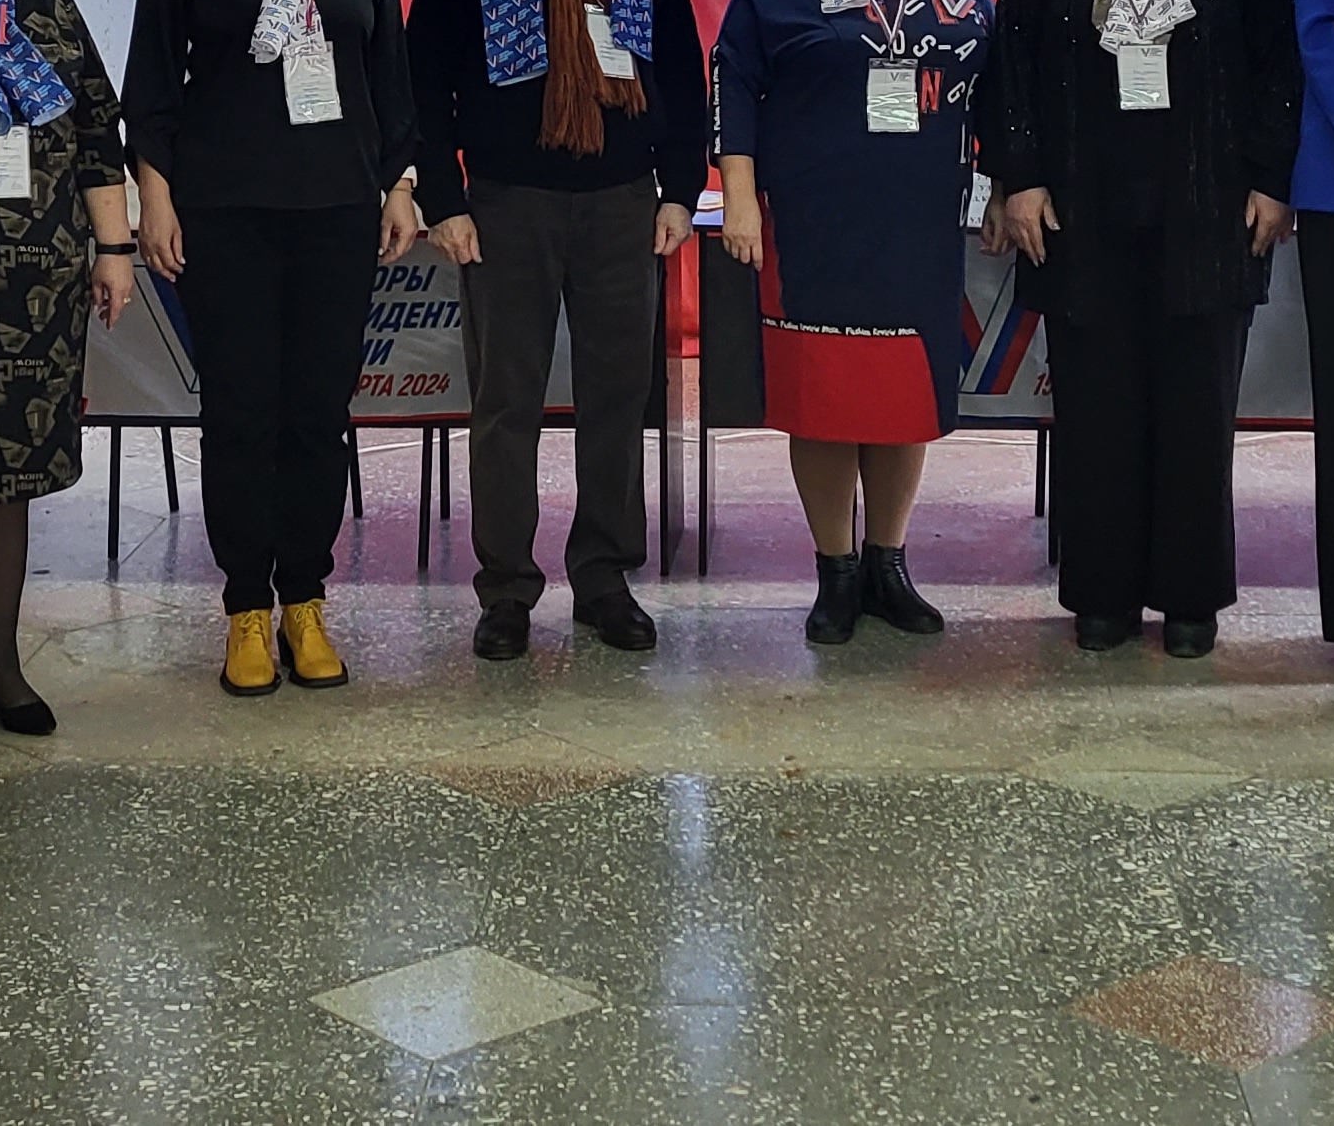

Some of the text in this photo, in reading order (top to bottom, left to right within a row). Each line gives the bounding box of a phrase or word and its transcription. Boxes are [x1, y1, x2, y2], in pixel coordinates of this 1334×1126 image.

[373, 265, 437, 292] ОРЫ
[367, 301, 461, 332] ИДЕНТ
[355, 373, 450, 396] РТА 2024
